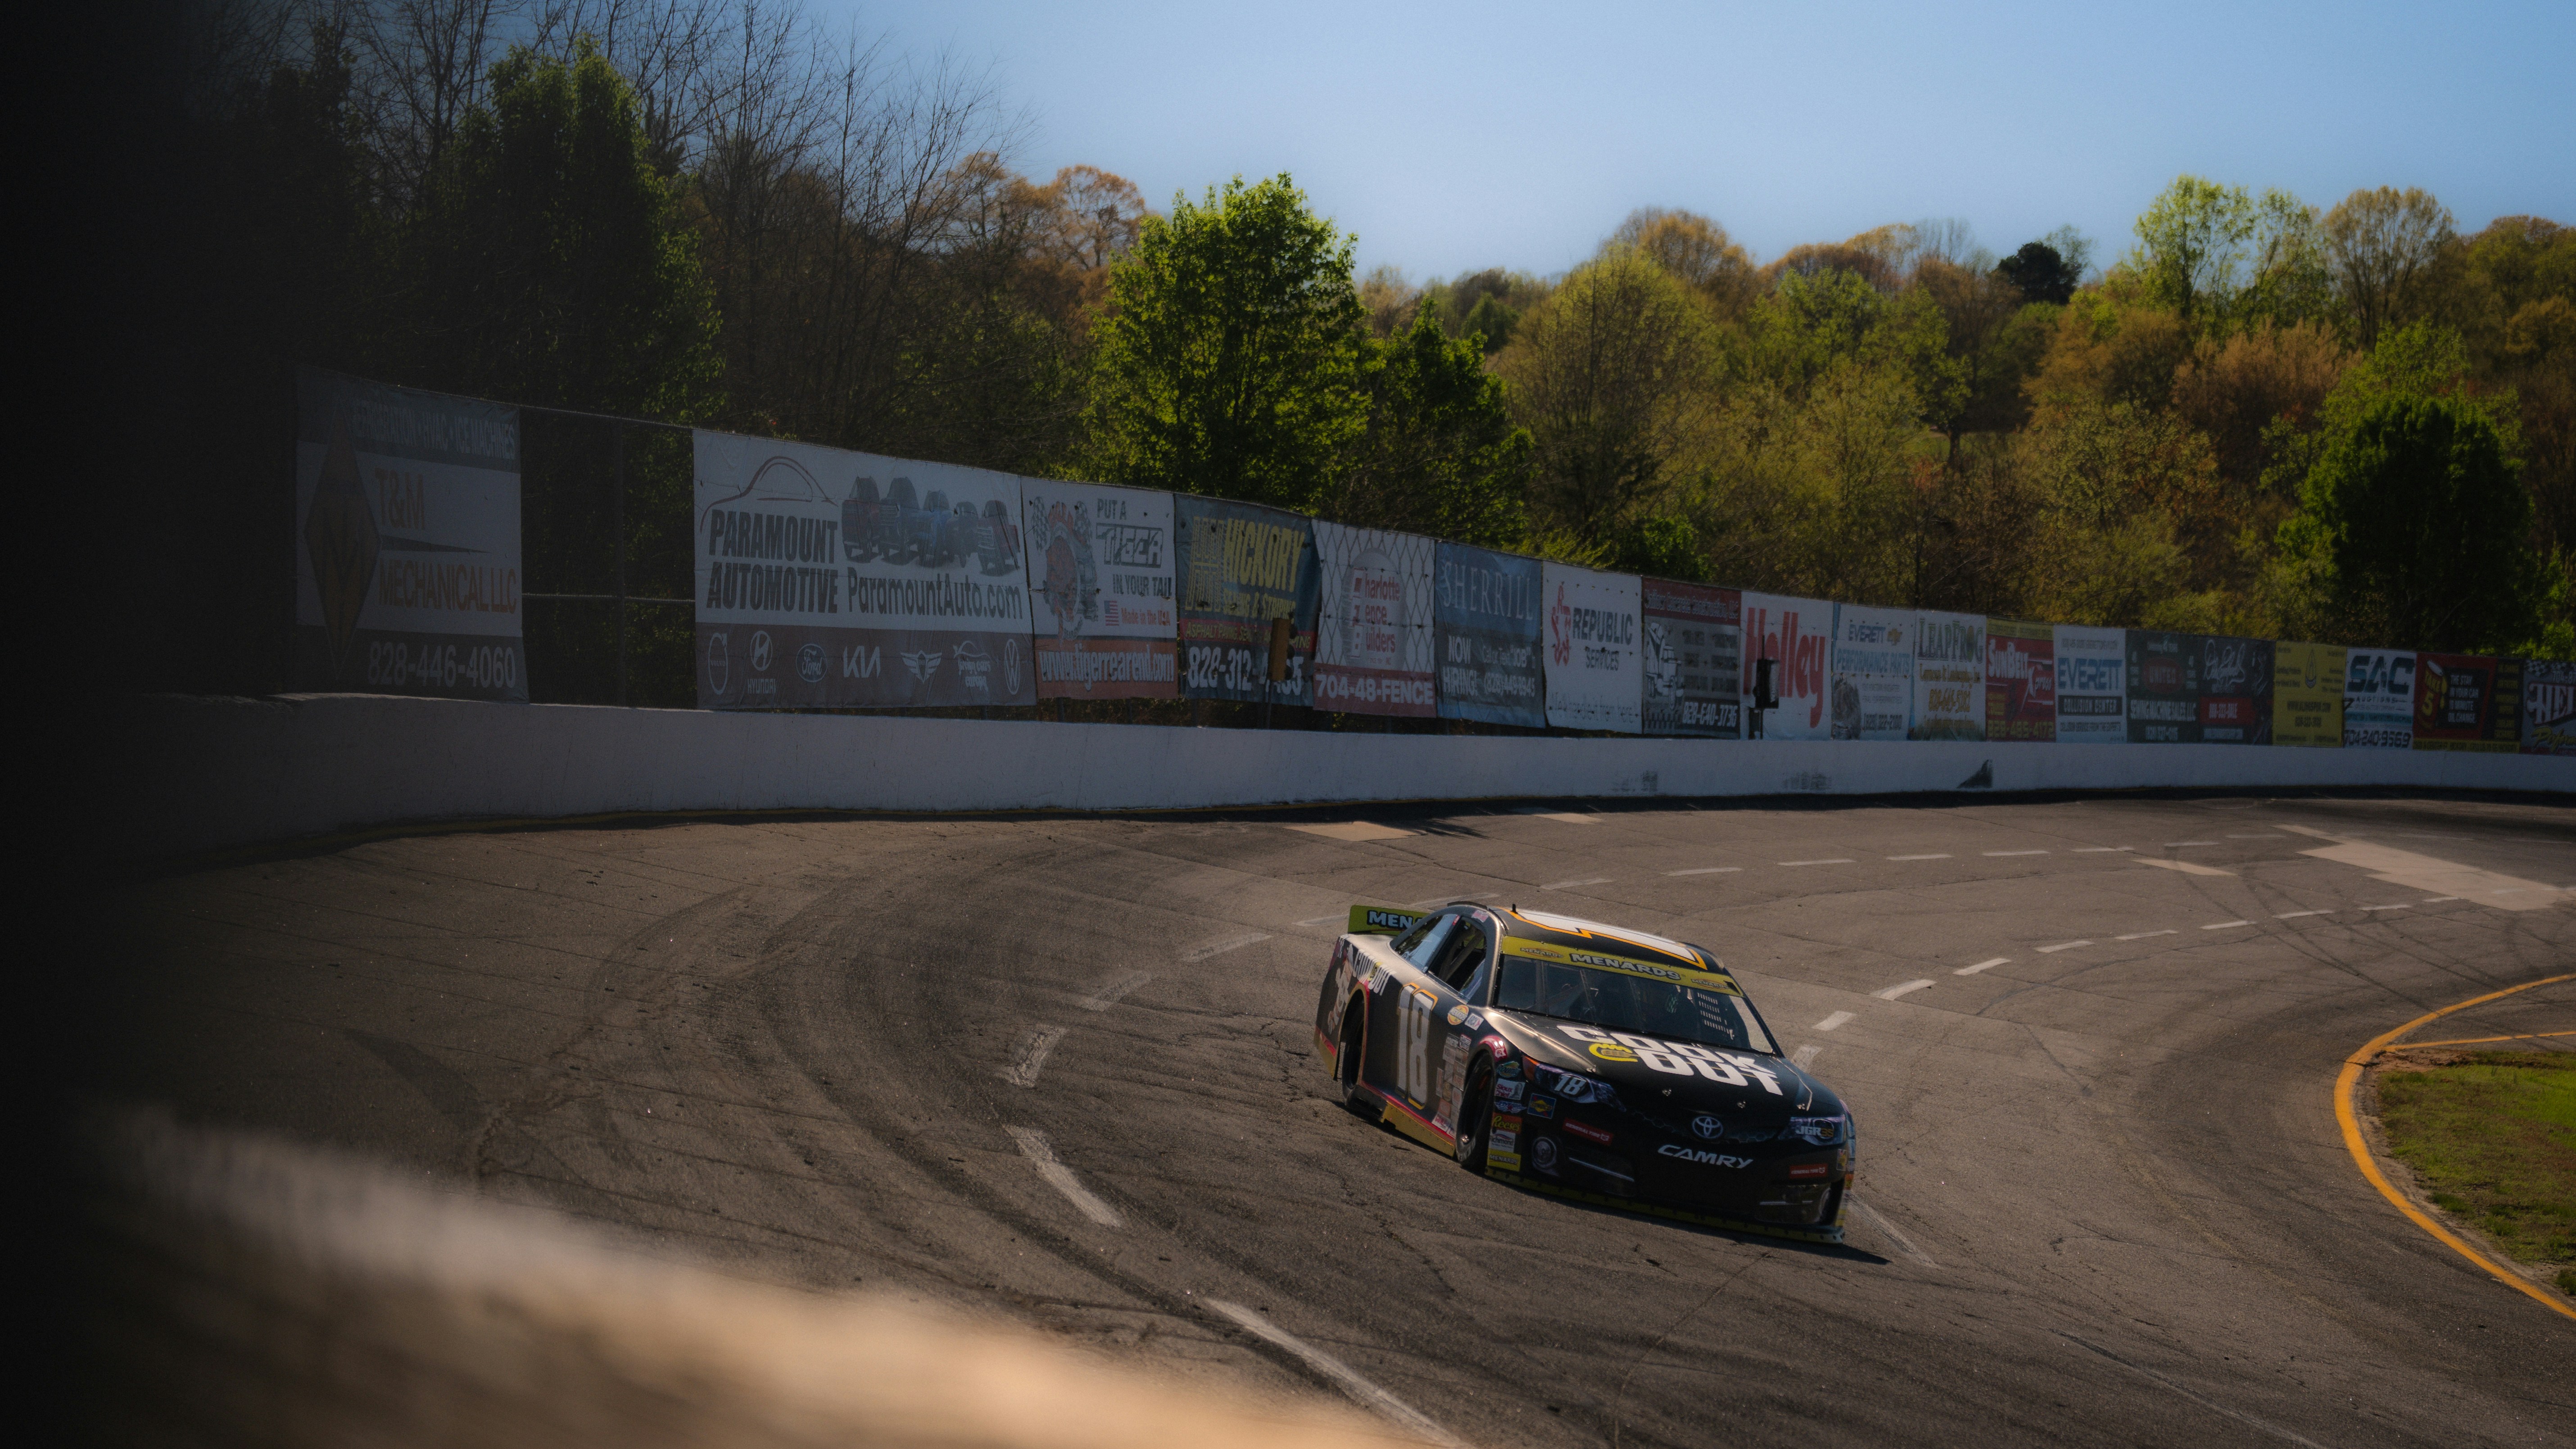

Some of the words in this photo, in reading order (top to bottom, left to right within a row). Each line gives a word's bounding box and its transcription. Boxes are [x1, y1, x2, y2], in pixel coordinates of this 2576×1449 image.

[375, 467, 425, 530] T&M
[1097, 498, 1117, 519] PUT
[1119, 501, 1127, 521] A
[708, 509, 838, 564] PARAMOUNT
[1223, 518, 1305, 593] HICKORY
[379, 558, 489, 611] MECHANICAL
[491, 567, 517, 614] LLC
[706, 562, 838, 614] AUTOMOTIVE
[847, 566, 1023, 620] ParamountAuto.com
[1113, 574, 1124, 595] IN
[1125, 575, 1150, 597] YOUR
[1152, 577, 1172, 597] TAIL
[1443, 561, 1533, 620] SHERRILL
[1121, 607, 1139, 625] Made
[1140, 609, 1146, 625] in
[1147, 609, 1156, 625] the
[1185, 621, 1217, 639] ASPHALT
[1572, 607, 1633, 645] REPUBLIC
[1848, 624, 1886, 643] EVERETT
[801, 648, 823, 675] Ford
[1448, 635, 1471, 664] NOW
[1585, 648, 1620, 671] SERVICES
[368, 641, 516, 688] 828-446-4060
[1038, 643, 1174, 692] www.tigerrearend.com
[2057, 657, 2123, 691] EVERETT
[2347, 655, 2415, 695] SAC
[747, 678, 776, 694] HYUNDAI
[1315, 674, 1434, 705] 704-48-FENCE
[2451, 675, 2459, 685] THE
[2460, 675, 2473, 686] STAY
[2456, 687, 2468, 698] YOUR
[2063, 698, 2093, 714] COLLISION
[2094, 698, 2117, 714] CENTER
[1520, 947, 1564, 959] MENARDS
[1569, 953, 1681, 981] MENARDS
[1397, 982, 1438, 1109] 18
[1556, 1025, 1778, 1079] COOK
[1553, 1074, 1586, 1095] 18
[1633, 1048, 1784, 1096] OUT
[1496, 1083, 1513, 1093] Sioux
[1489, 1155, 1518, 1165] MENARDS
[1657, 1144, 1754, 1169] CAMRY
